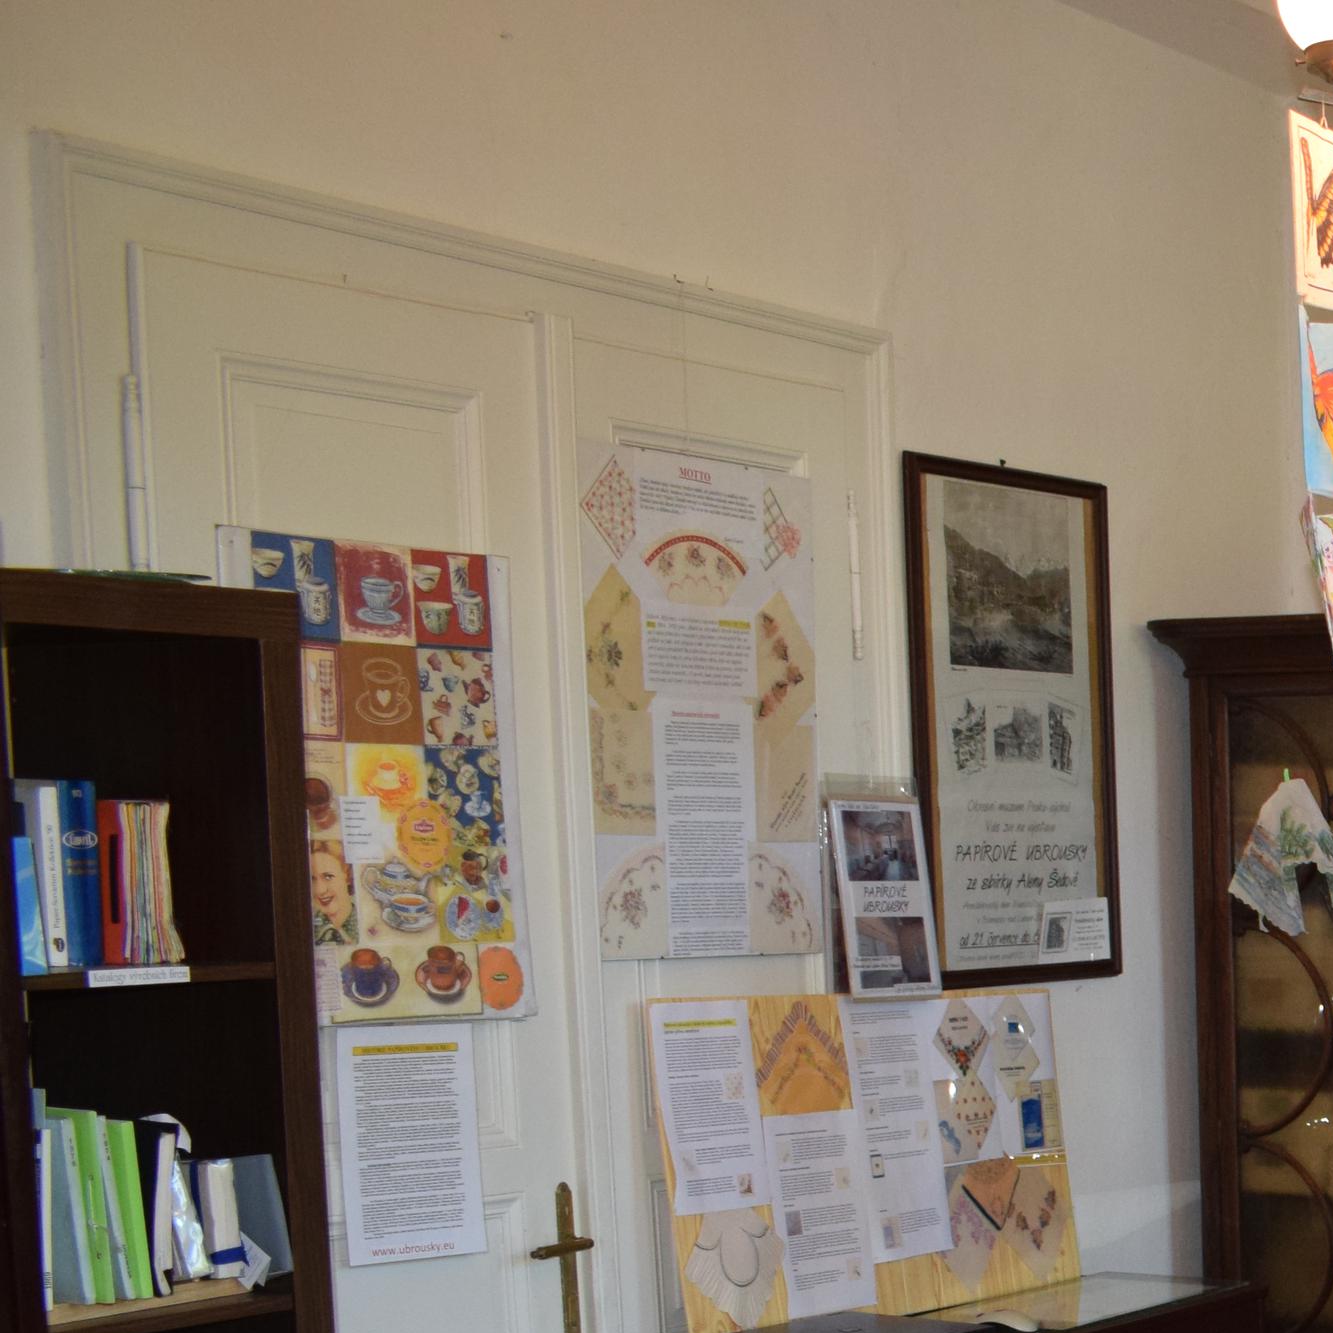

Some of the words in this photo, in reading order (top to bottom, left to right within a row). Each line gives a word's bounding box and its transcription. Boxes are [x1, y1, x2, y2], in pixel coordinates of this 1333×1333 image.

[680, 467, 711, 481] MOTTO
[955, 840, 1017, 863] PAPÍROVÉ
[1026, 844, 1088, 862] UBROUSKY
[863, 883, 908, 898] PAPÍROVÉ
[92, 971, 125, 985] Katalogy
[372, 1241, 455, 1257] www.ubrousky.eu
